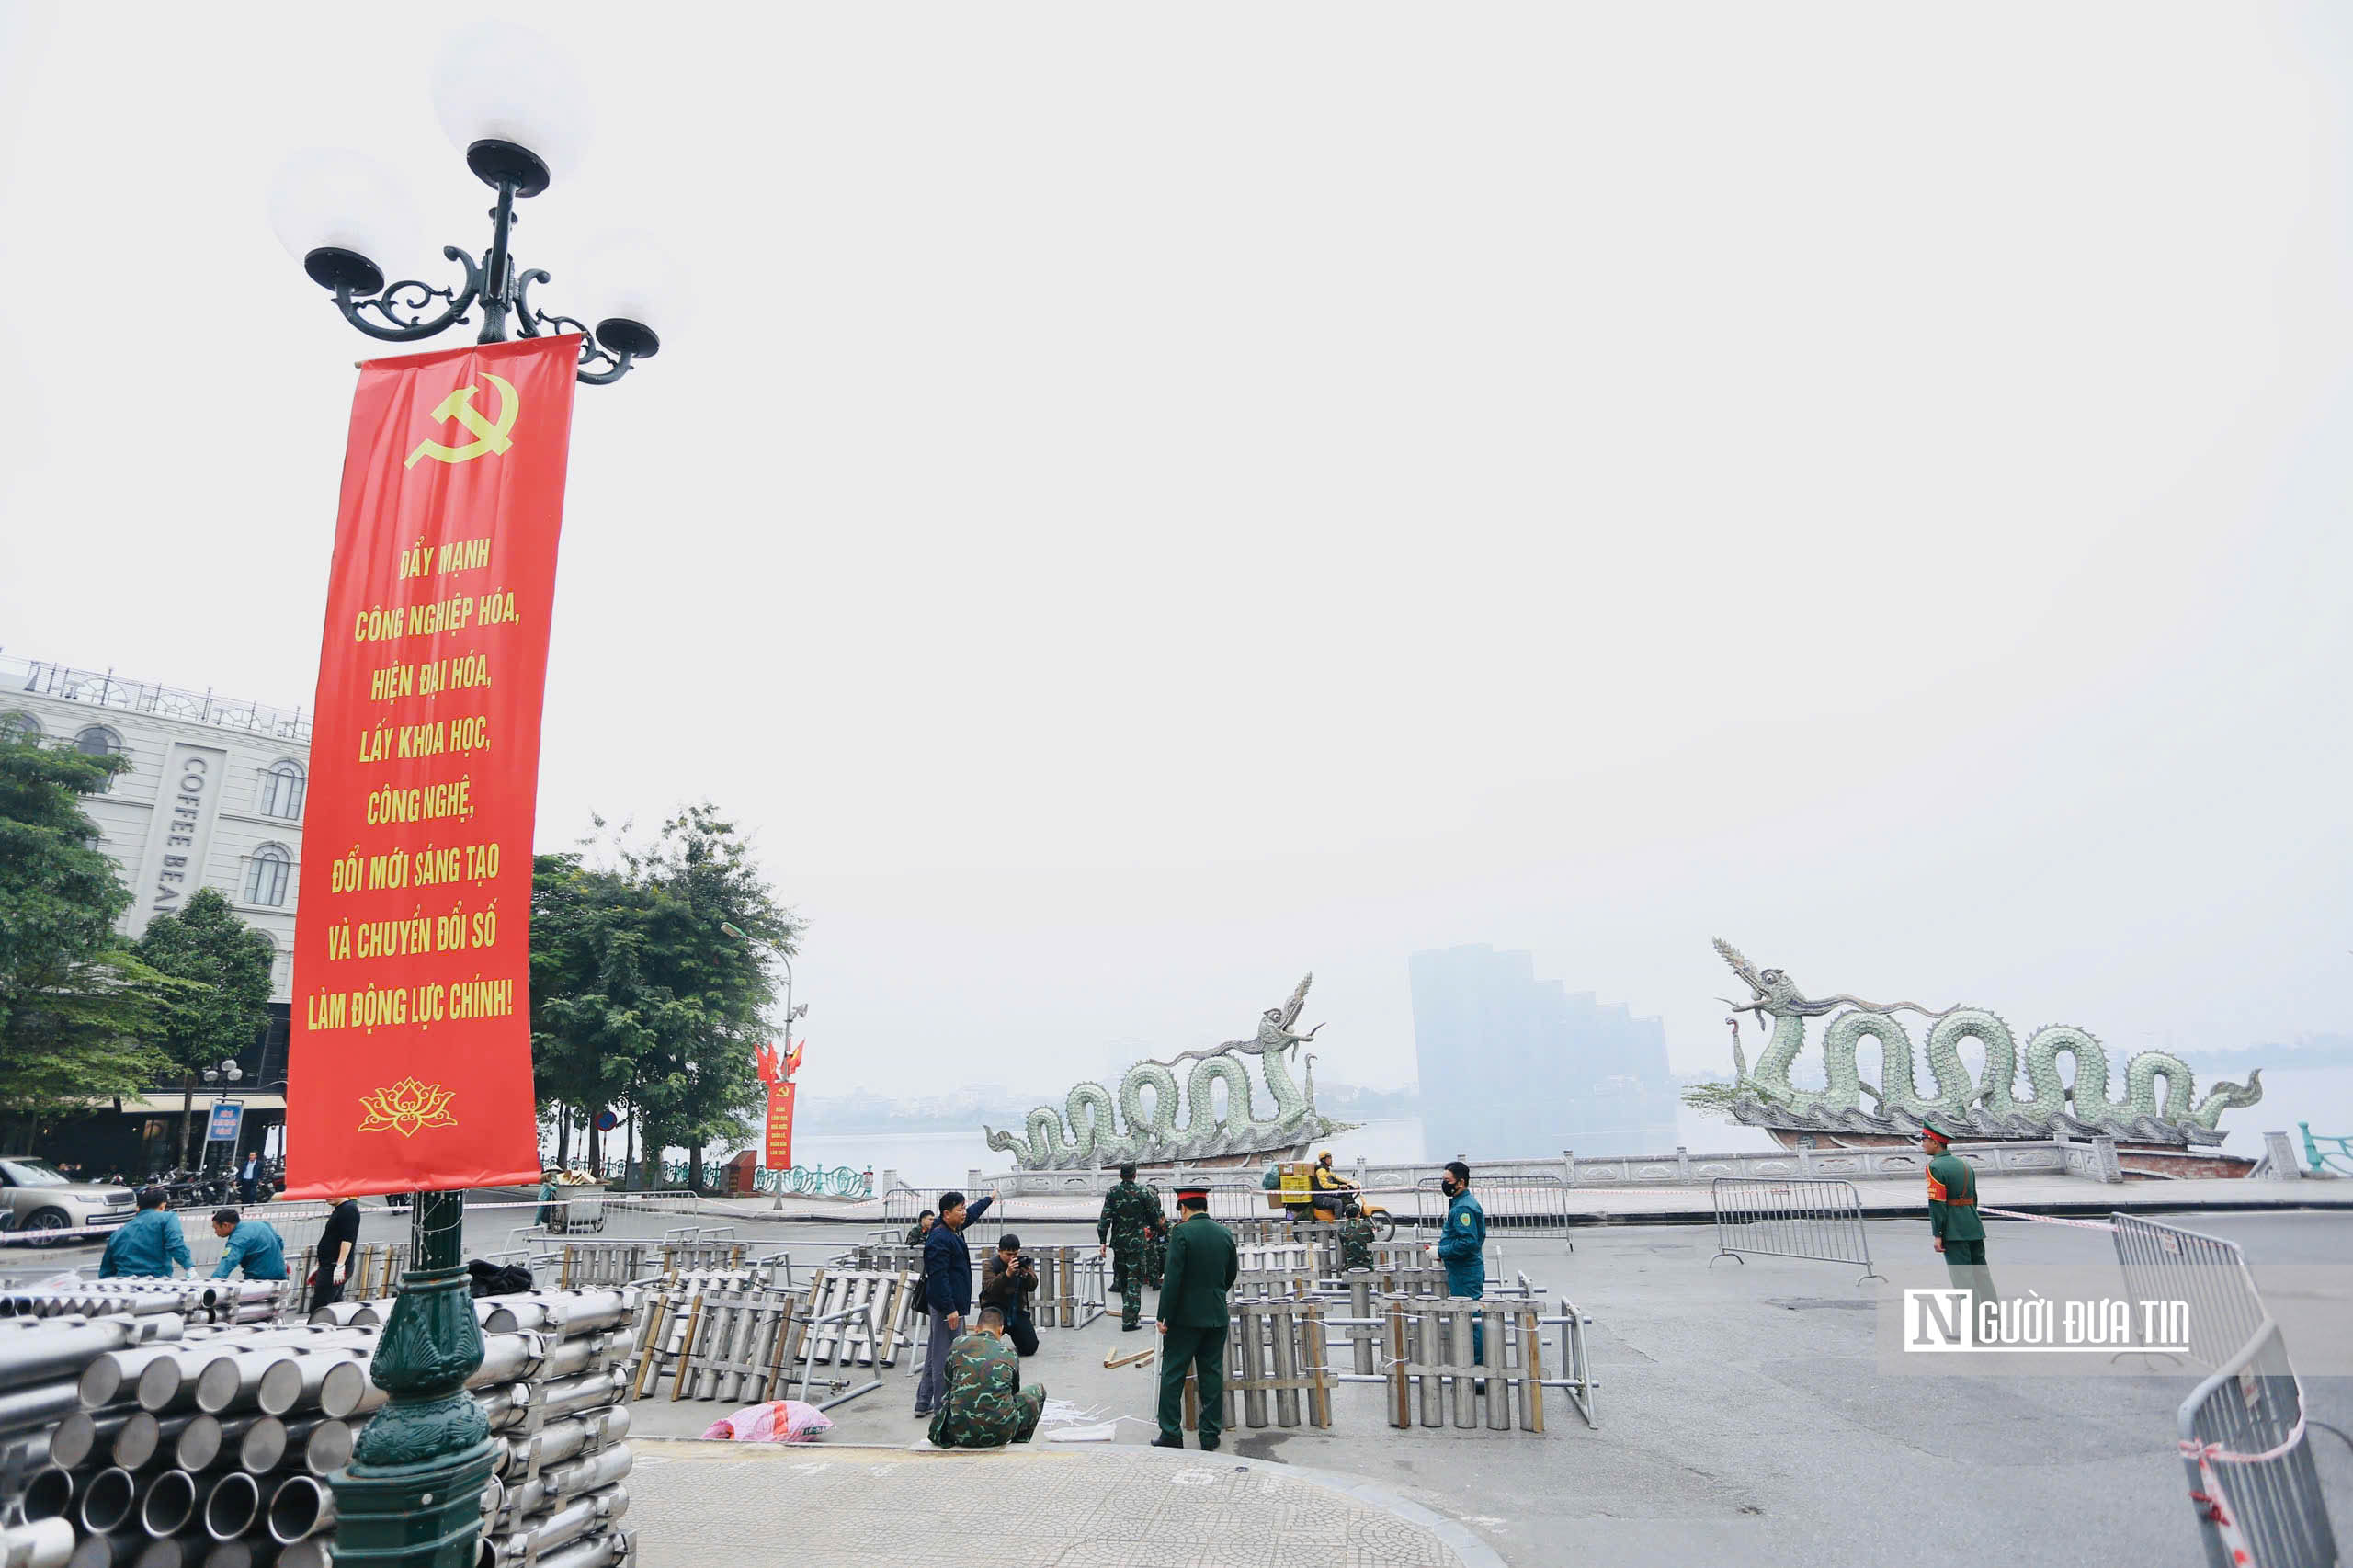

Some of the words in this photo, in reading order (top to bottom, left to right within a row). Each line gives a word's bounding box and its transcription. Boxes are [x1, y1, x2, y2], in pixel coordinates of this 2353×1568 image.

[399, 535, 435, 579] ĐẨY
[438, 538, 490, 576] MẠNH
[355, 604, 404, 642] CÔNG
[408, 592, 473, 635] NGHIỆP
[478, 586, 519, 625] HÓA,
[371, 660, 414, 705] HIỆN
[419, 659, 447, 699] ĐẠI
[451, 649, 491, 689] HÓA,
[359, 717, 393, 762] LẤY
[398, 722, 444, 757] KHOA
[450, 716, 490, 757] HỌC,
[167, 756, 208, 846] COFFEE
[368, 784, 420, 824] CÔNG
[423, 773, 474, 822] NGHỆ,
[332, 844, 363, 892] ĐỔI
[369, 848, 409, 890] MỚI
[415, 843, 460, 886] SÁNG
[466, 844, 499, 887] TẠO
[328, 917, 351, 960] VÀ
[358, 904, 431, 958] CHUYỂN
[437, 900, 467, 950] ĐỔI
[472, 898, 498, 948] SỐ
[309, 987, 346, 1029] LÀM
[351, 983, 406, 1034] ĐỘNG
[412, 983, 444, 1029] LỰC
[450, 973, 512, 1019] CHÍNH!
